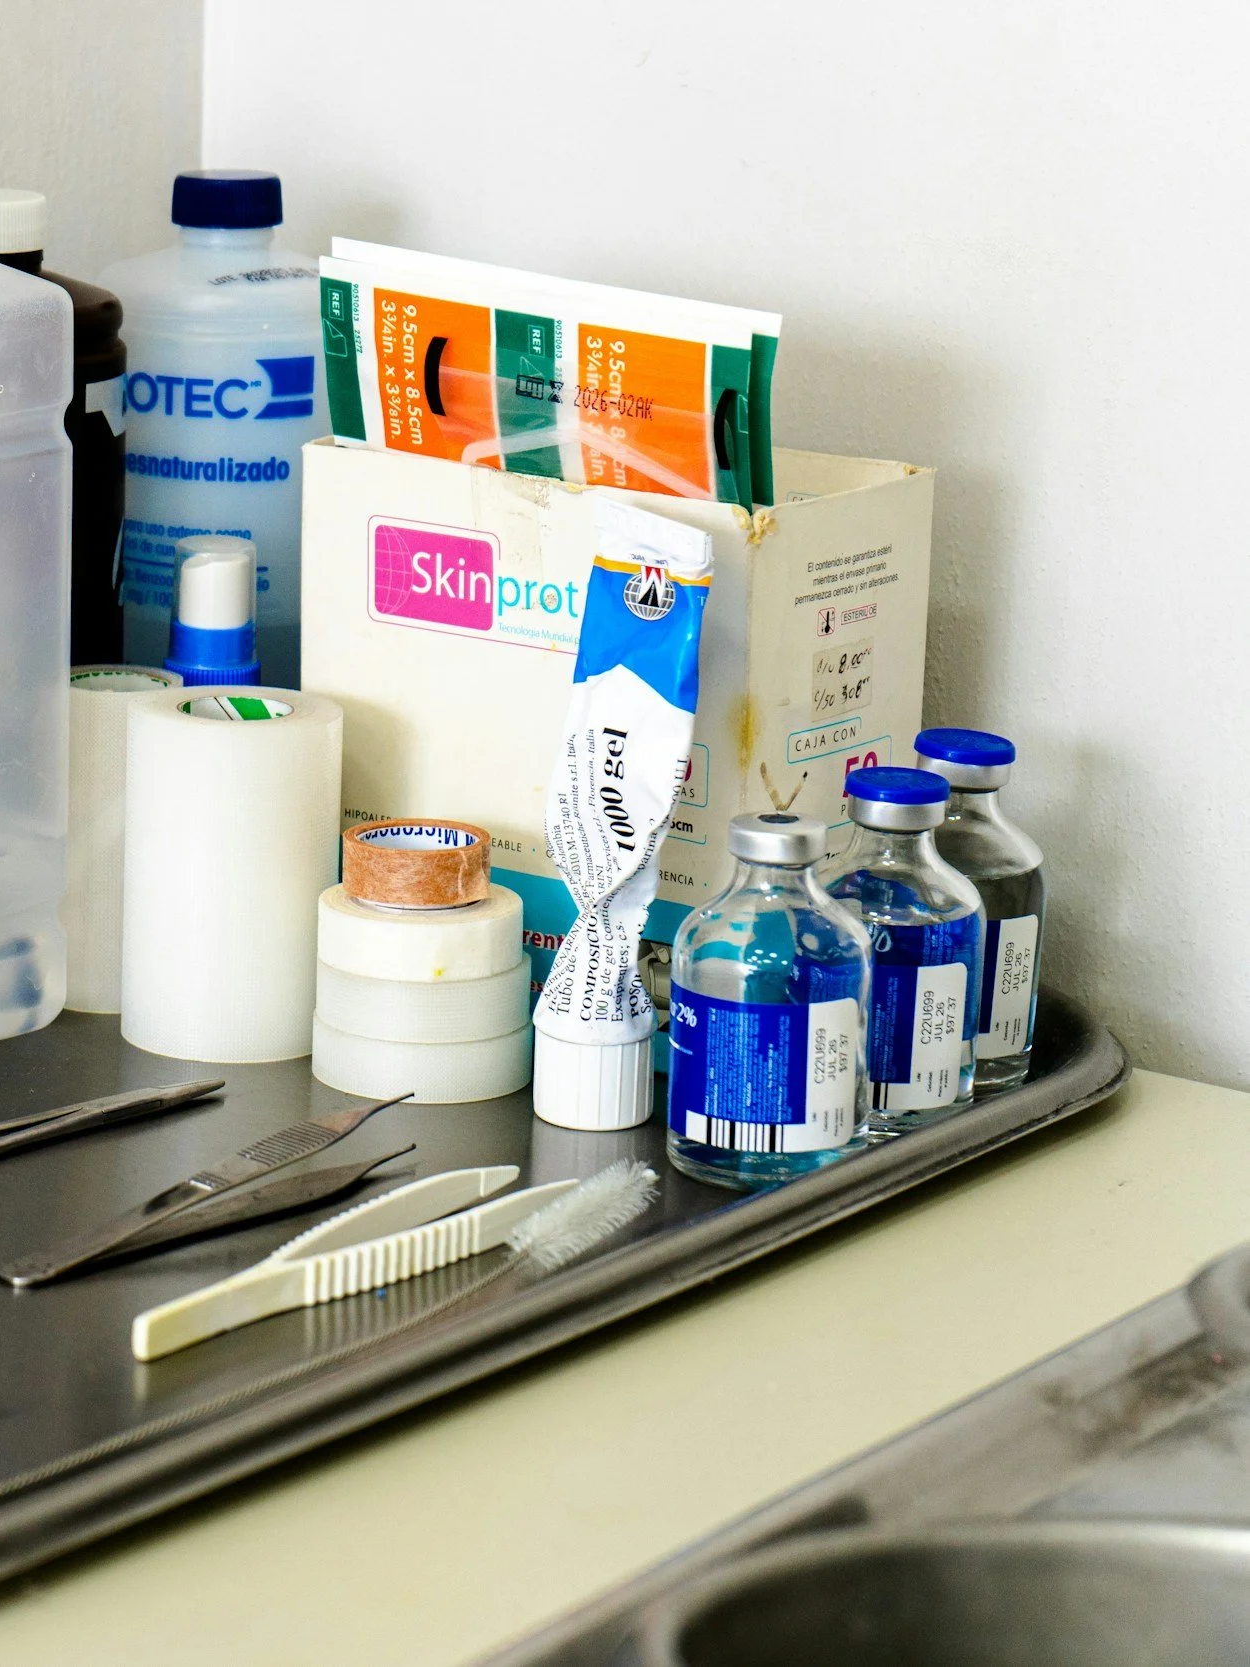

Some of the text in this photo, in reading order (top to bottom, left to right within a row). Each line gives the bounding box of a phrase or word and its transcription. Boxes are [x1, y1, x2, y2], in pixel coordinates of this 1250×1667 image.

[331, 292, 341, 317] REF
[123, 372, 249, 420] OTEC
[795, 726, 857, 752] CAJA CON
[599, 727, 636, 852] 1000 gel
[602, 944, 616, 965] gel
[600, 968, 611, 982] de
[1012, 972, 1021, 992] JUL
[595, 1000, 609, 1021] 100
[934, 1019, 944, 1043] JUL
